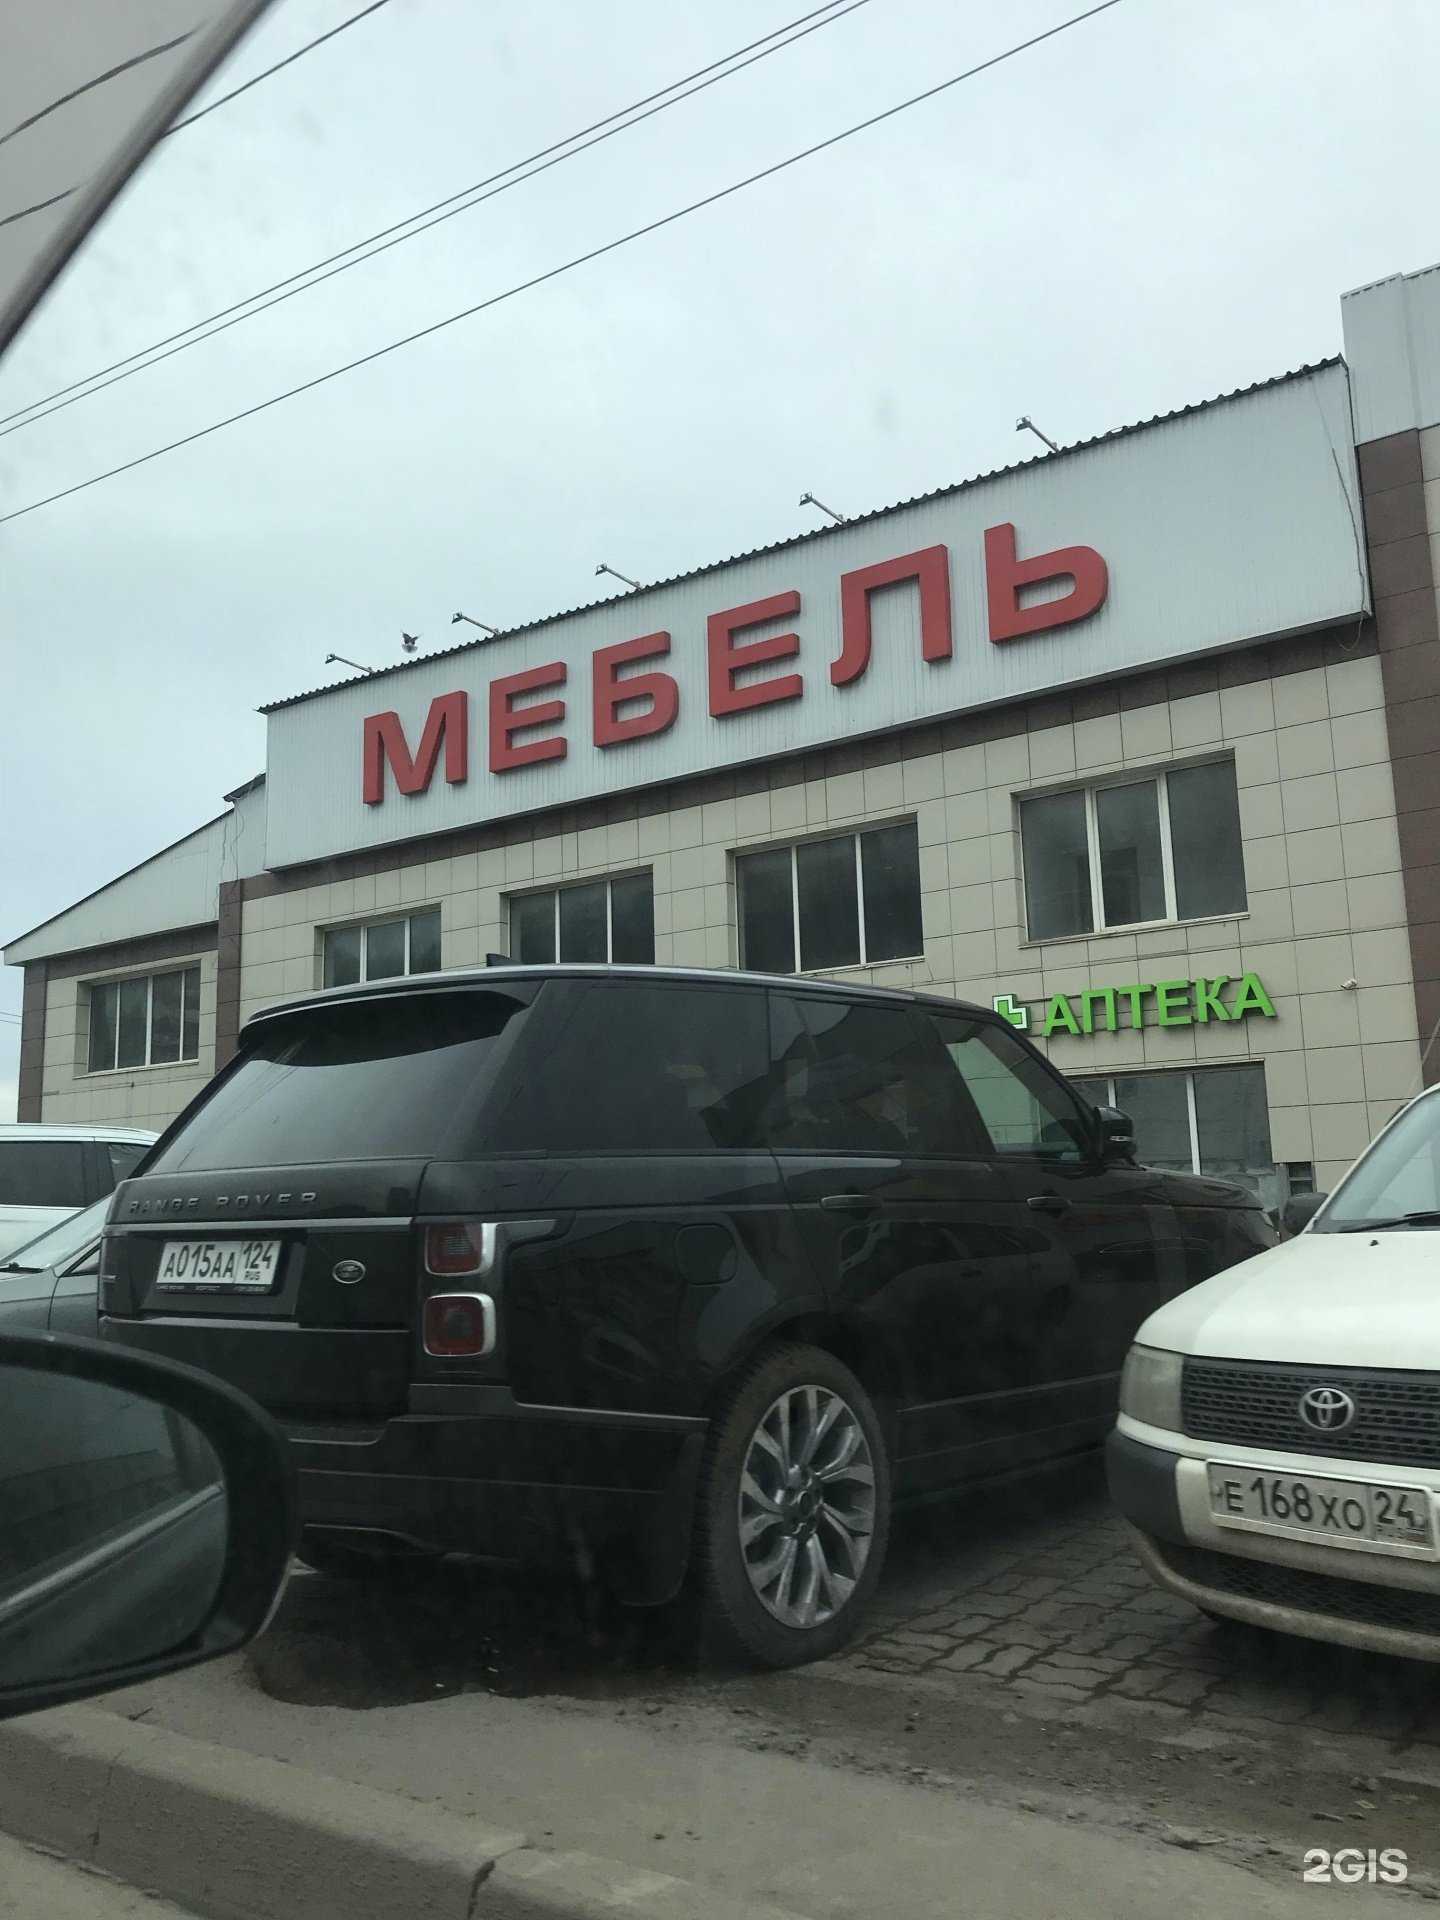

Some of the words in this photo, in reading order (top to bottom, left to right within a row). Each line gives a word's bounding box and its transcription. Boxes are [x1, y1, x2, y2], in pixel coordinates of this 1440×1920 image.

[363, 522, 1109, 807] МЕБЕЛЬ
[1041, 972, 1277, 1038] АПТЕКА
[129, 1197, 200, 1214] RANGE
[216, 1192, 317, 1209] ROVER
